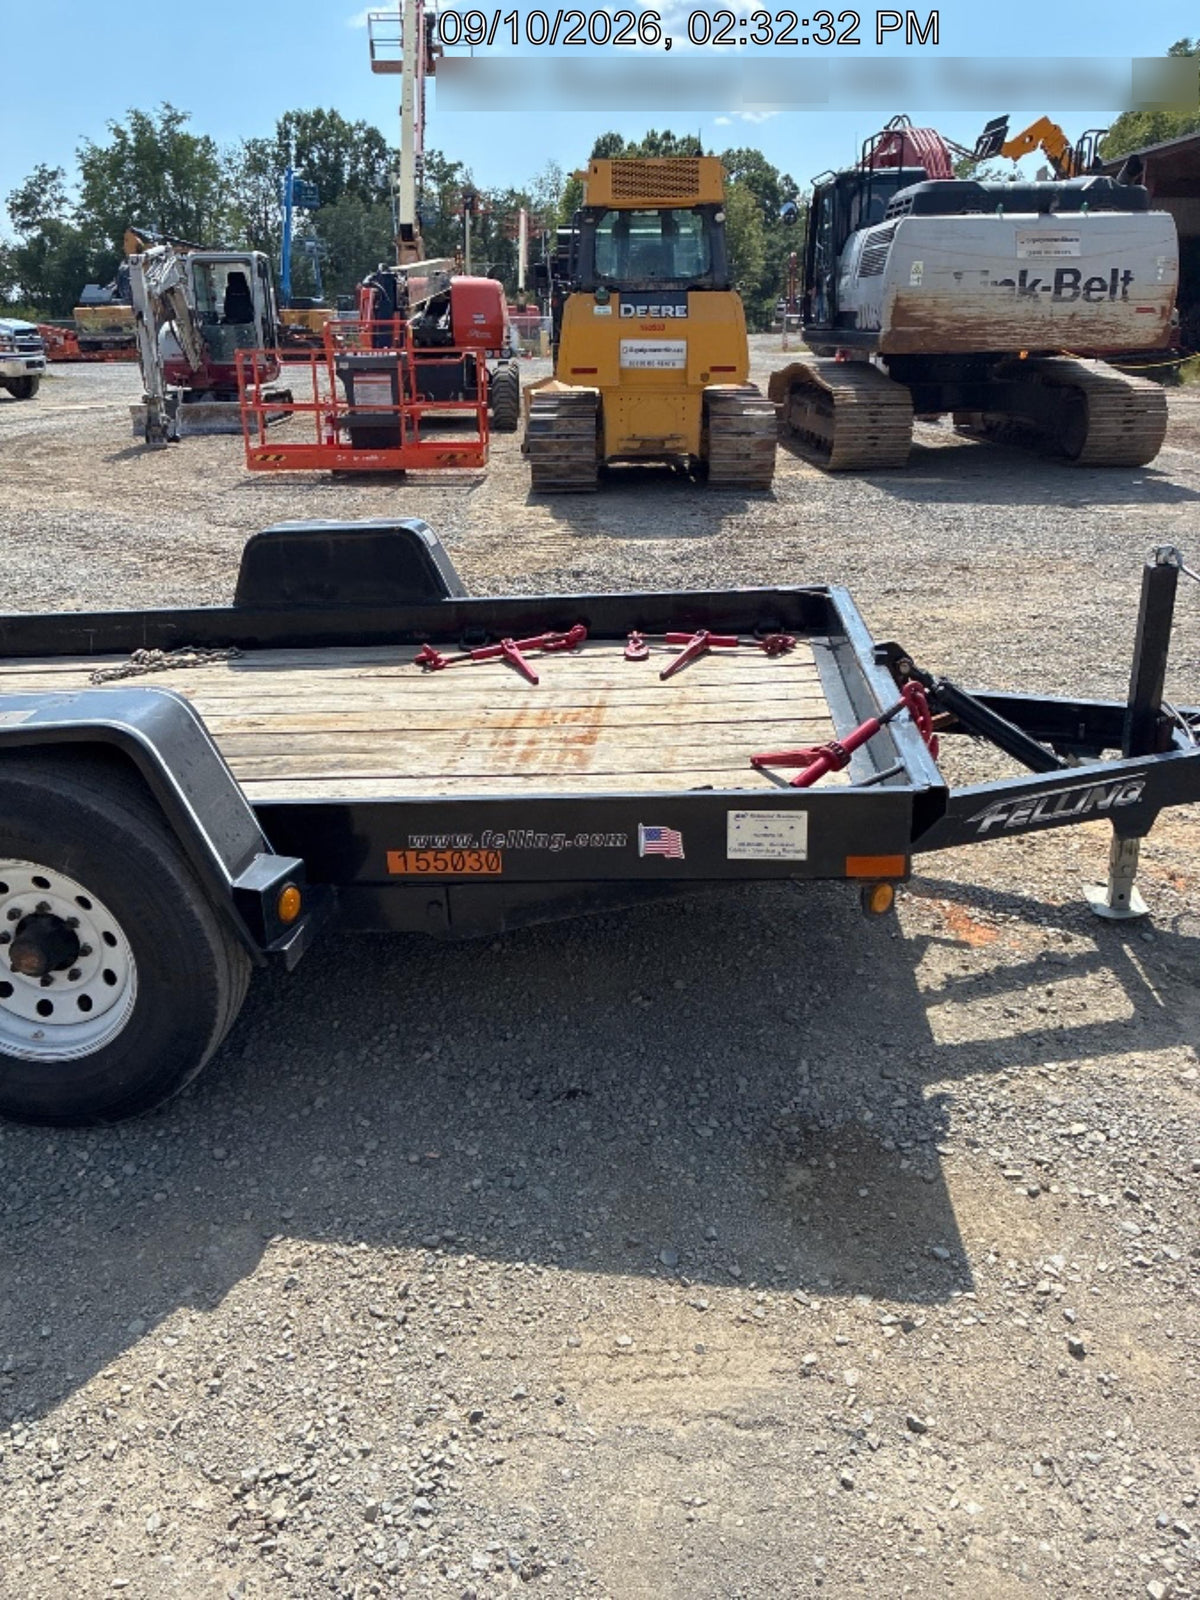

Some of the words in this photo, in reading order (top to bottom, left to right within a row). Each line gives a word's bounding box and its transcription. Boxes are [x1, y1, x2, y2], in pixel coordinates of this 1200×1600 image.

[953, 267, 1134, 303] k-Belt
[620, 303, 687, 318] DEERE
[966, 776, 1147, 833] FELLING
[408, 830, 628, 851] www.felling.com
[397, 850, 500, 872] 155030
